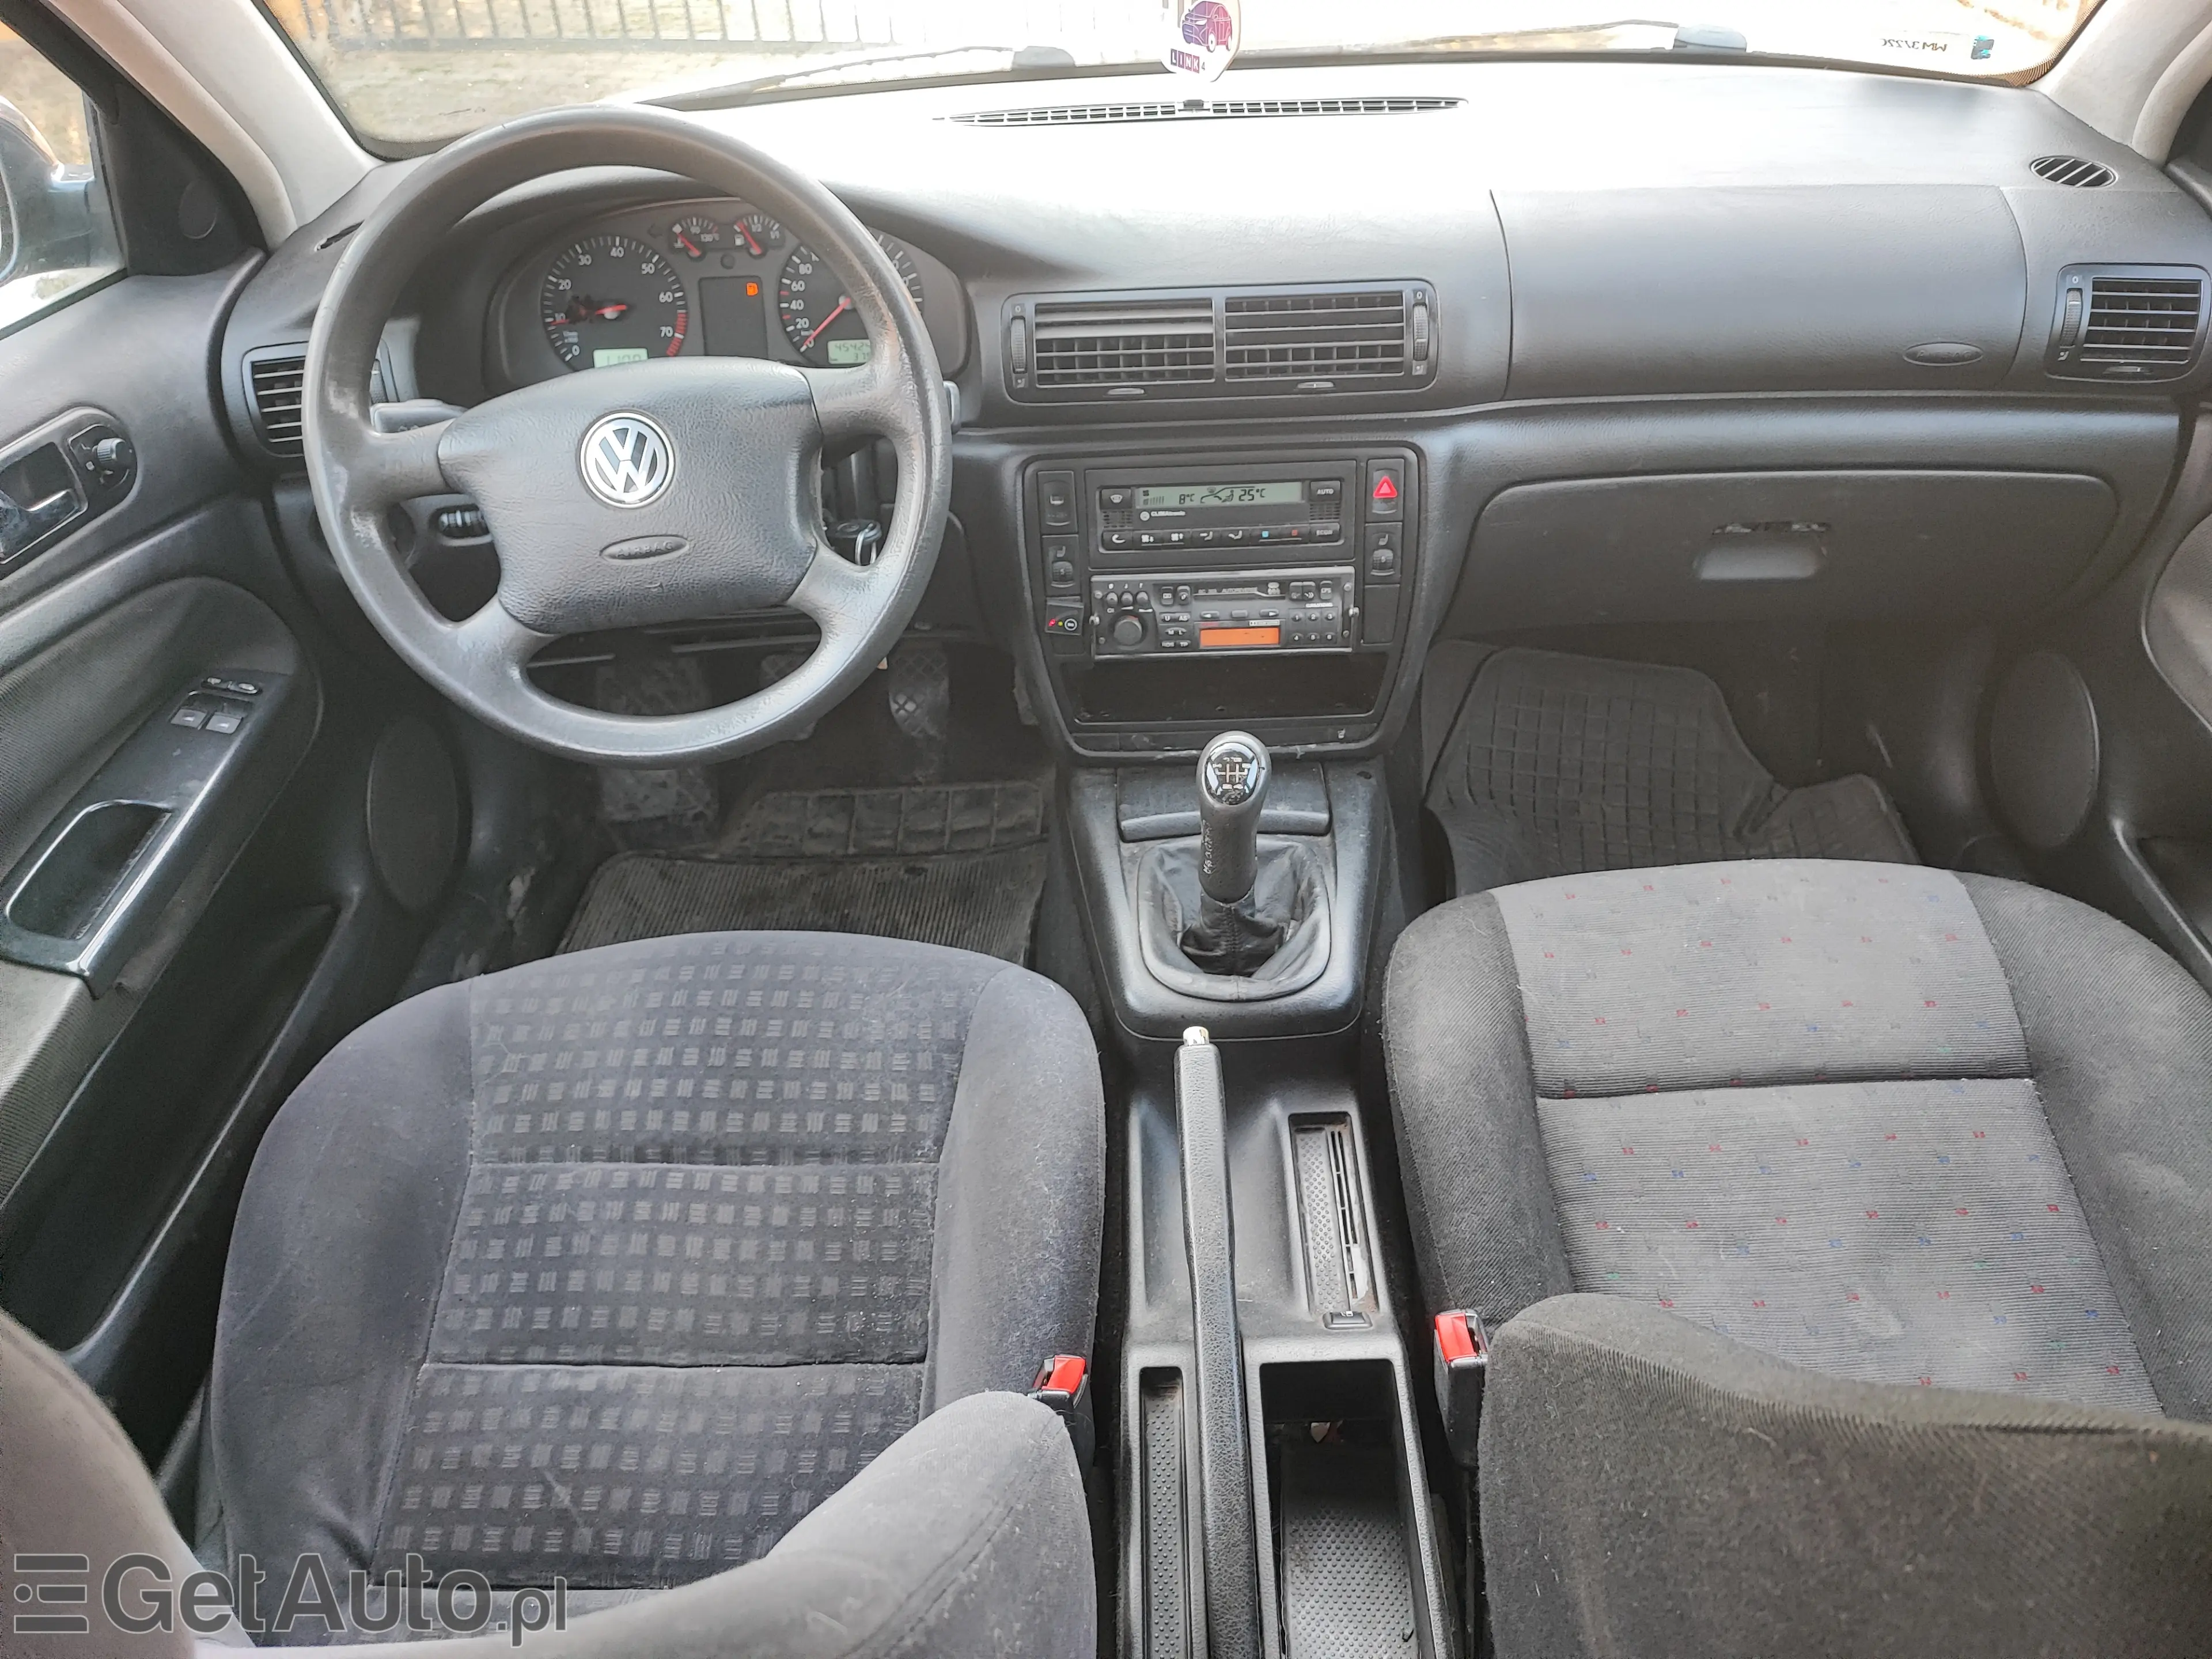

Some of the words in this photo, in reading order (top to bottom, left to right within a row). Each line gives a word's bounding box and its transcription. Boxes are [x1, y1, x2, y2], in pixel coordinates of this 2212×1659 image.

[610, 247, 624, 258] 40
[578, 254, 592, 266] 30
[641, 263, 655, 274] 50
[798, 263, 813, 275] 80
[558, 279, 571, 290] 20
[791, 280, 805, 291] 60
[658, 291, 673, 302] 60
[790, 299, 805, 310] 40
[796, 318, 810, 329] 20
[660, 326, 673, 337] 70
[571, 345, 580, 356] 0
[1238, 488, 1266, 502] 25°C
